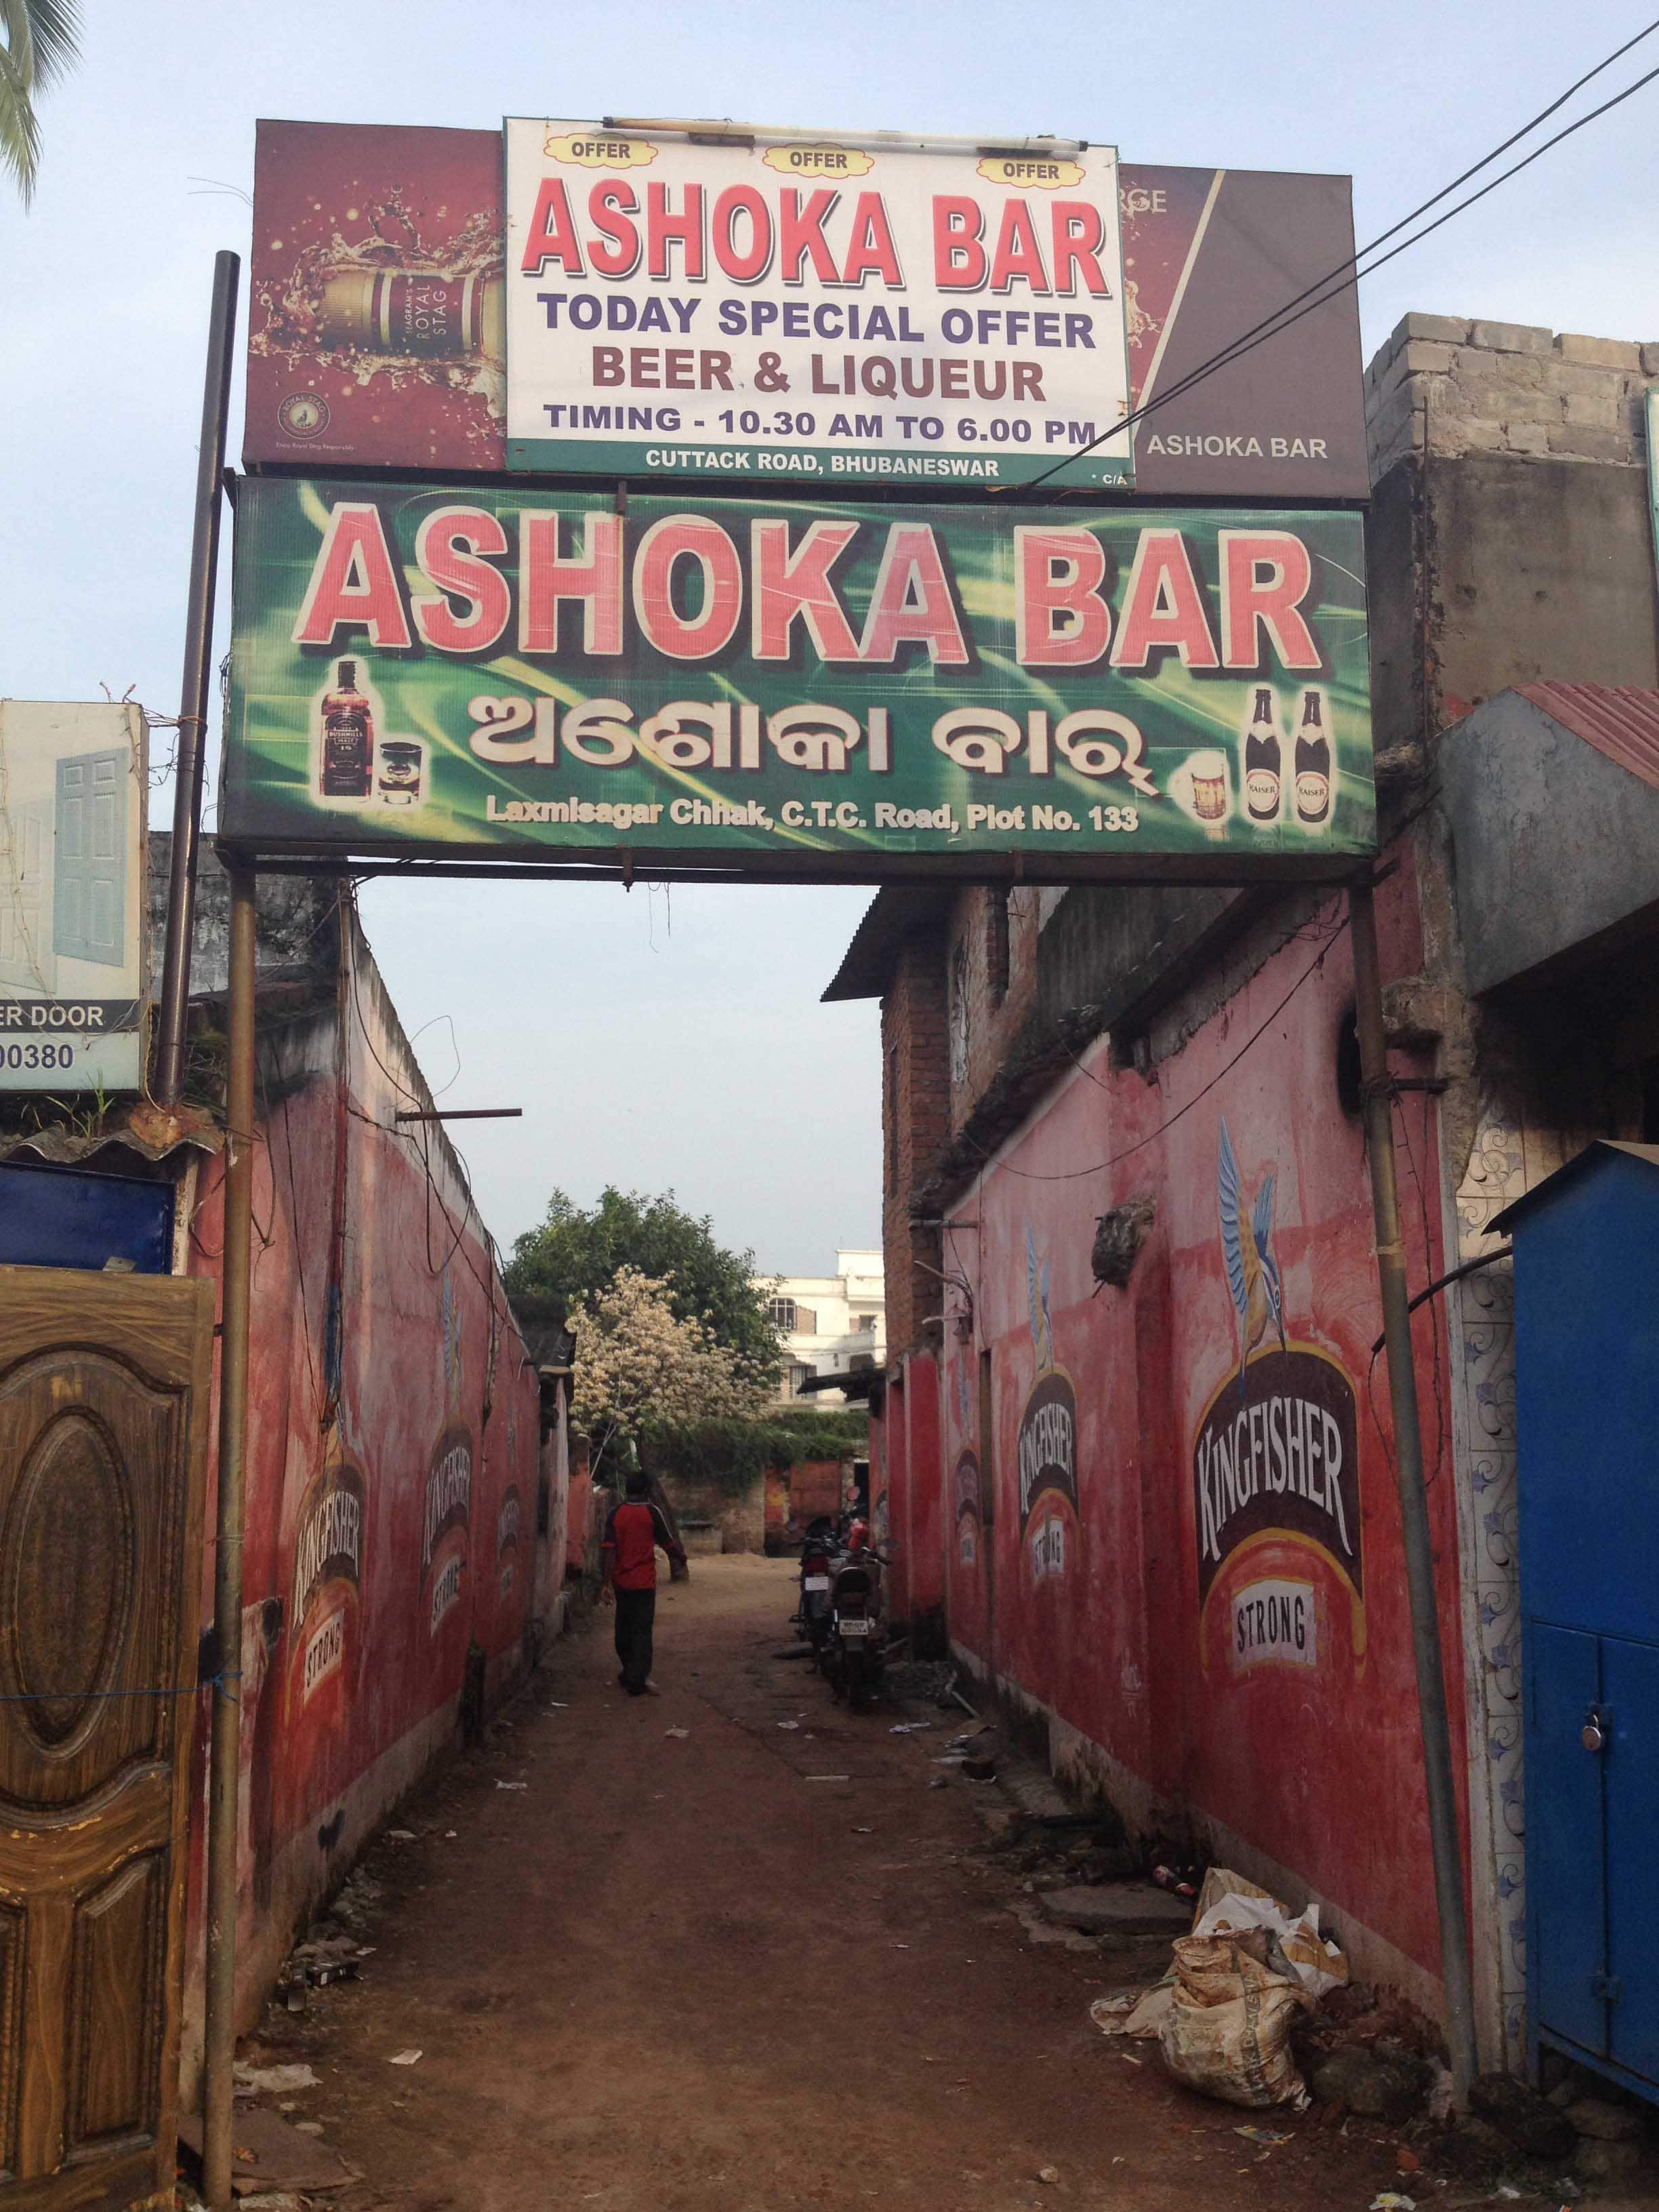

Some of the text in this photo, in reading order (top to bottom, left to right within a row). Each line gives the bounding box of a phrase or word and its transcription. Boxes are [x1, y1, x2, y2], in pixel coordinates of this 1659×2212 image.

[571, 141, 631, 159] OFFER
[790, 151, 848, 169] OFFER
[1002, 163, 1060, 180] OFFER
[520, 178, 1112, 298] ASHOKA BAR
[415, 285, 430, 339] ROYAL
[432, 290, 447, 335] STAG
[537, 293, 1097, 349] TODAY SPECIAL OFFER
[592, 346, 1047, 402] BEER & LIQUEUR
[543, 404, 681, 431] TIMING
[718, 410, 816, 435] 10.30
[828, 414, 882, 438] AM
[895, 415, 945, 440] TO
[957, 418, 1031, 442] 6.00
[1044, 420, 1096, 445] PM
[645, 449, 1000, 476] CUTTACK ROAD, BHUBANESWAR
[1147, 435, 1328, 459] ASHOKA BAR
[291, 502, 1322, 669] ASHOKA BAR
[1249, 783, 1275, 794] KAISER
[1298, 786, 1325, 797] KAISER
[670, 798, 774, 830] Chhak,
[781, 800, 867, 828] C.T.C.
[875, 802, 960, 833] Road,
[967, 804, 1025, 830] Plot
[1032, 806, 1080, 832] No.
[1088, 806, 1139, 832] 133
[0, 1006, 104, 1027] R DOOR
[1197, 1395, 1353, 1561] KINGFISHER
[293, 1490, 361, 1629] KINGFISHER
[1237, 1594, 1305, 1654] STRONG
[307, 1622, 340, 1688] STRONG
